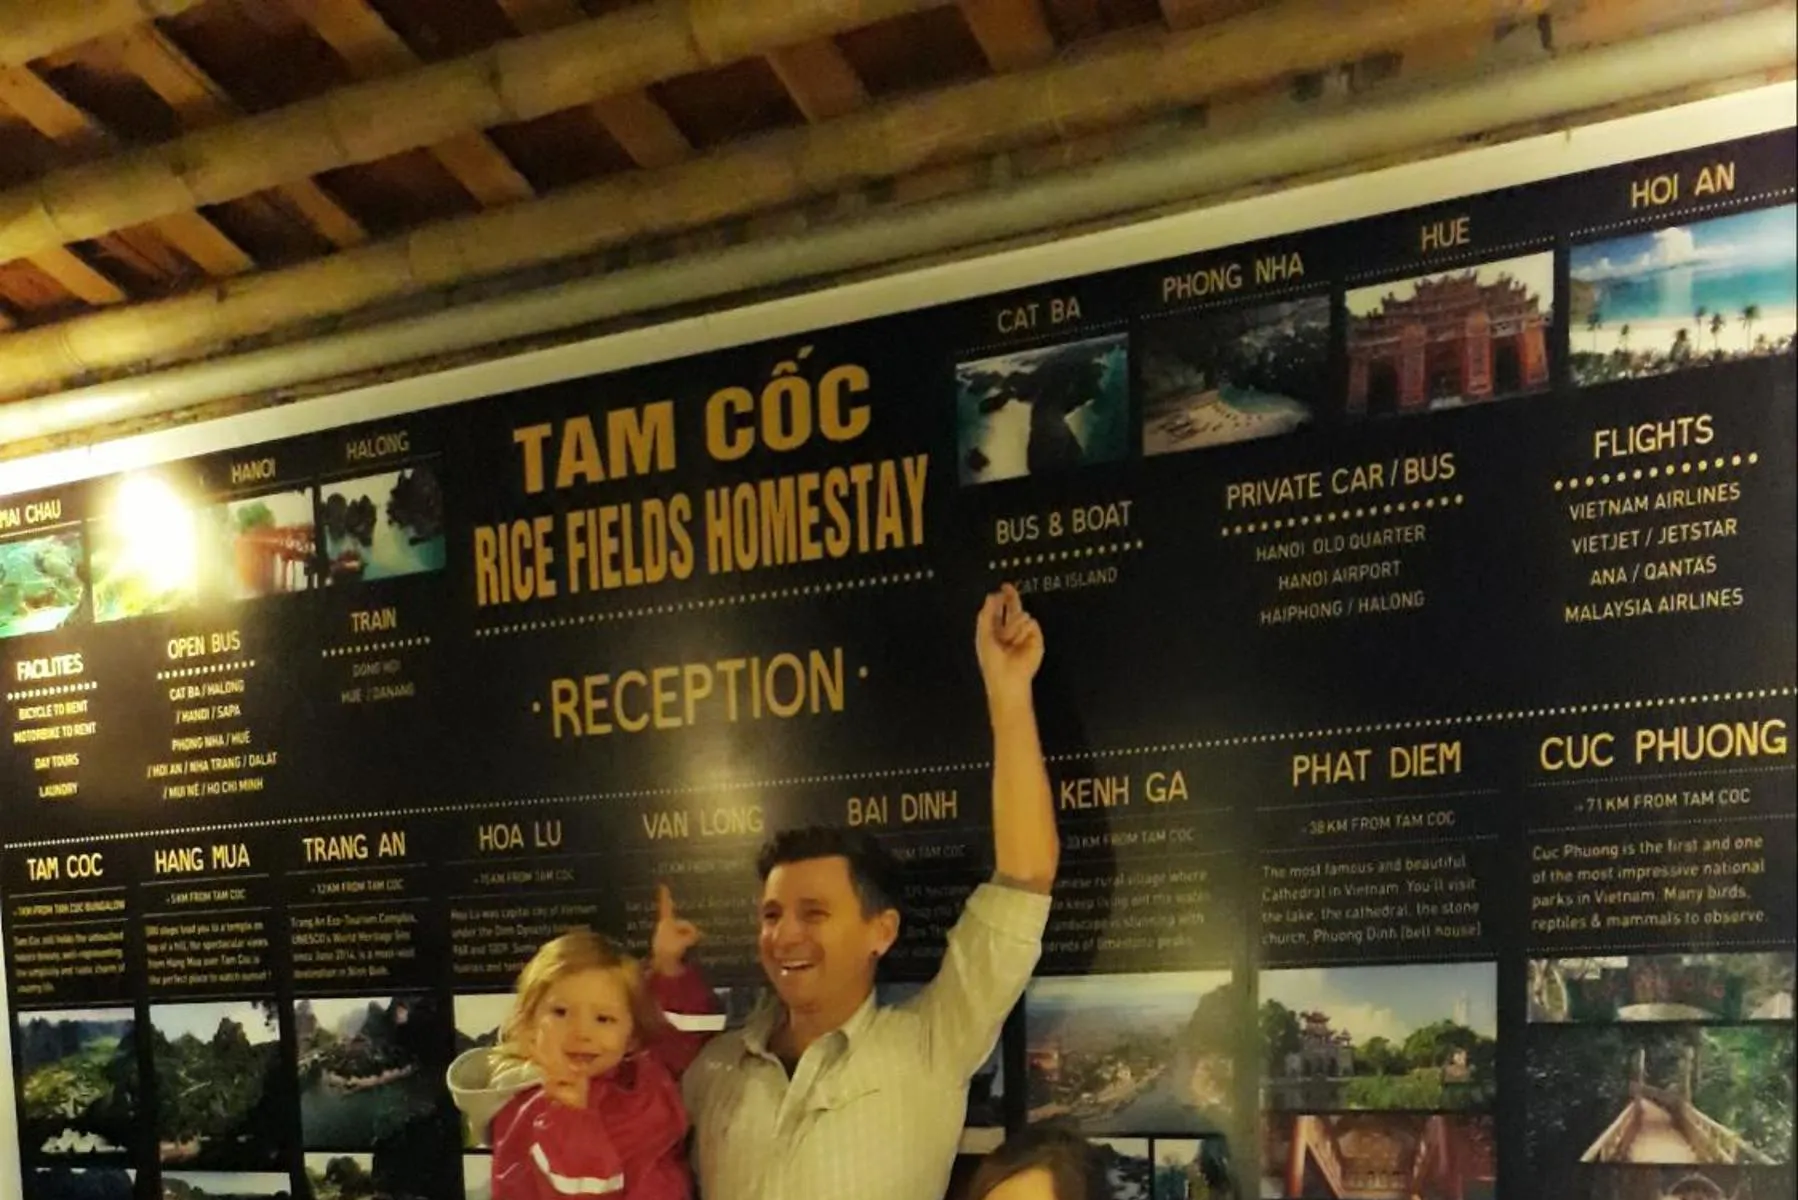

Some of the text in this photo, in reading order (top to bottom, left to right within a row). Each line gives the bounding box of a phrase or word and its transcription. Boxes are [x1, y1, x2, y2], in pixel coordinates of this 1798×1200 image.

[1631, 162, 1735, 209] HOI AN
[1421, 217, 1470, 251] HUE
[1163, 252, 1304, 302] PHONG NHA
[998, 296, 1081, 333] CAT BA
[513, 346, 871, 493] TAM CỐC
[346, 431, 410, 460] HALONG
[1594, 414, 1714, 460] FLIGHTS
[232, 458, 275, 484] HANOI
[1226, 453, 1455, 511] PRIVATE CAR BUS
[25, 499, 61, 524] CHAU
[1569, 482, 1741, 521] VIETNAM AIRLINES
[474, 453, 928, 606] RICE FIELDS HOMESTAY
[996, 501, 1132, 545] BUS & BOAT
[1572, 518, 1738, 554] VIETJET JETSTAR
[1256, 524, 1426, 561] HANOI OLD QUARTER
[1043, 575, 1061, 592] BA
[1065, 566, 1118, 588] ISLAND
[1279, 560, 1401, 590] HANOI AIRPORT
[1590, 556, 1717, 586] ANA QANTAS
[351, 609, 397, 633] TRAIN
[1260, 590, 1425, 624] HAIPHONG HALONG
[1565, 588, 1743, 623] MALAYSIA AIRLINES
[168, 630, 240, 660] OPEN BUS
[16, 653, 84, 682] FACILITIES
[169, 687, 186, 701] CAT
[188, 685, 200, 698] BA
[550, 647, 844, 738] RECEPTION
[1540, 719, 1787, 770] CUC PHUONG
[1293, 741, 1462, 787] PHAT DIEM
[1060, 771, 1188, 809] KENH GA
[1605, 795, 1629, 811] KM
[1634, 792, 1677, 808] FROM
[1682, 790, 1714, 806] TAM
[1718, 787, 1751, 804] COC
[643, 806, 764, 839] VAN LONG
[847, 790, 957, 827] BAI DINH
[1351, 816, 1391, 831] FROM
[1395, 814, 1423, 828] TAM
[1427, 810, 1456, 826] COC
[303, 831, 406, 862] TRANG AN
[479, 820, 562, 850] HOA LU
[1141, 829, 1166, 843] TAM
[1169, 827, 1194, 842] COC
[1532, 845, 1559, 861] Cuc
[1564, 843, 1619, 860] Phuong
[1640, 841, 1663, 854] the
[1668, 838, 1698, 852] first
[1703, 836, 1730, 850] and
[1734, 835, 1763, 848] one
[27, 852, 103, 881] TAM COC
[155, 843, 250, 873] HANG MUA
[1550, 869, 1573, 883] the
[1577, 866, 1614, 881] most
[1703, 858, 1765, 874] national
